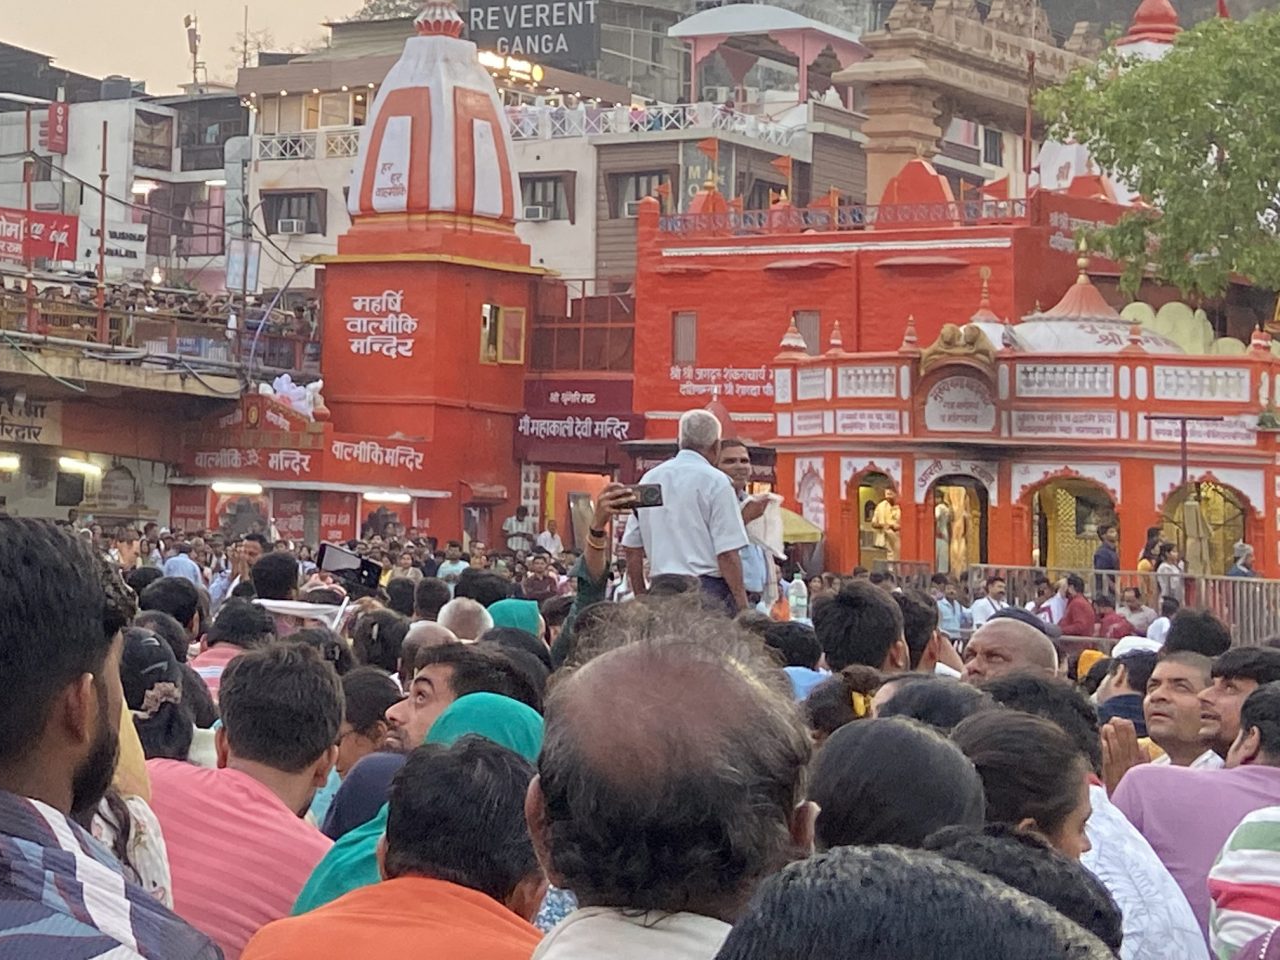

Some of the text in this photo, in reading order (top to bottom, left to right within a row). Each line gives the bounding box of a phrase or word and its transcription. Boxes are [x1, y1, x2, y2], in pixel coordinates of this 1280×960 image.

[470, 0, 600, 31] REVERENT
[496, 33, 569, 56] GANGA
[55, 106, 64, 134] OYO
[381, 162, 394, 175] हर
[391, 173, 403, 184] हर
[351, 290, 404, 315] महर्षि
[344, 312, 418, 336] वाल्मीकि
[348, 335, 415, 359] मन्दिर
[530, 415, 574, 439] महाकाली
[574, 416, 592, 439] देवी
[594, 417, 630, 440] मन्दिर
[195, 447, 243, 469] वाल्मीकि
[268, 449, 312, 476] मन्दिर
[331, 440, 425, 472] वाल्मीकि मन्दिर
[917, 458, 944, 488] आरती
